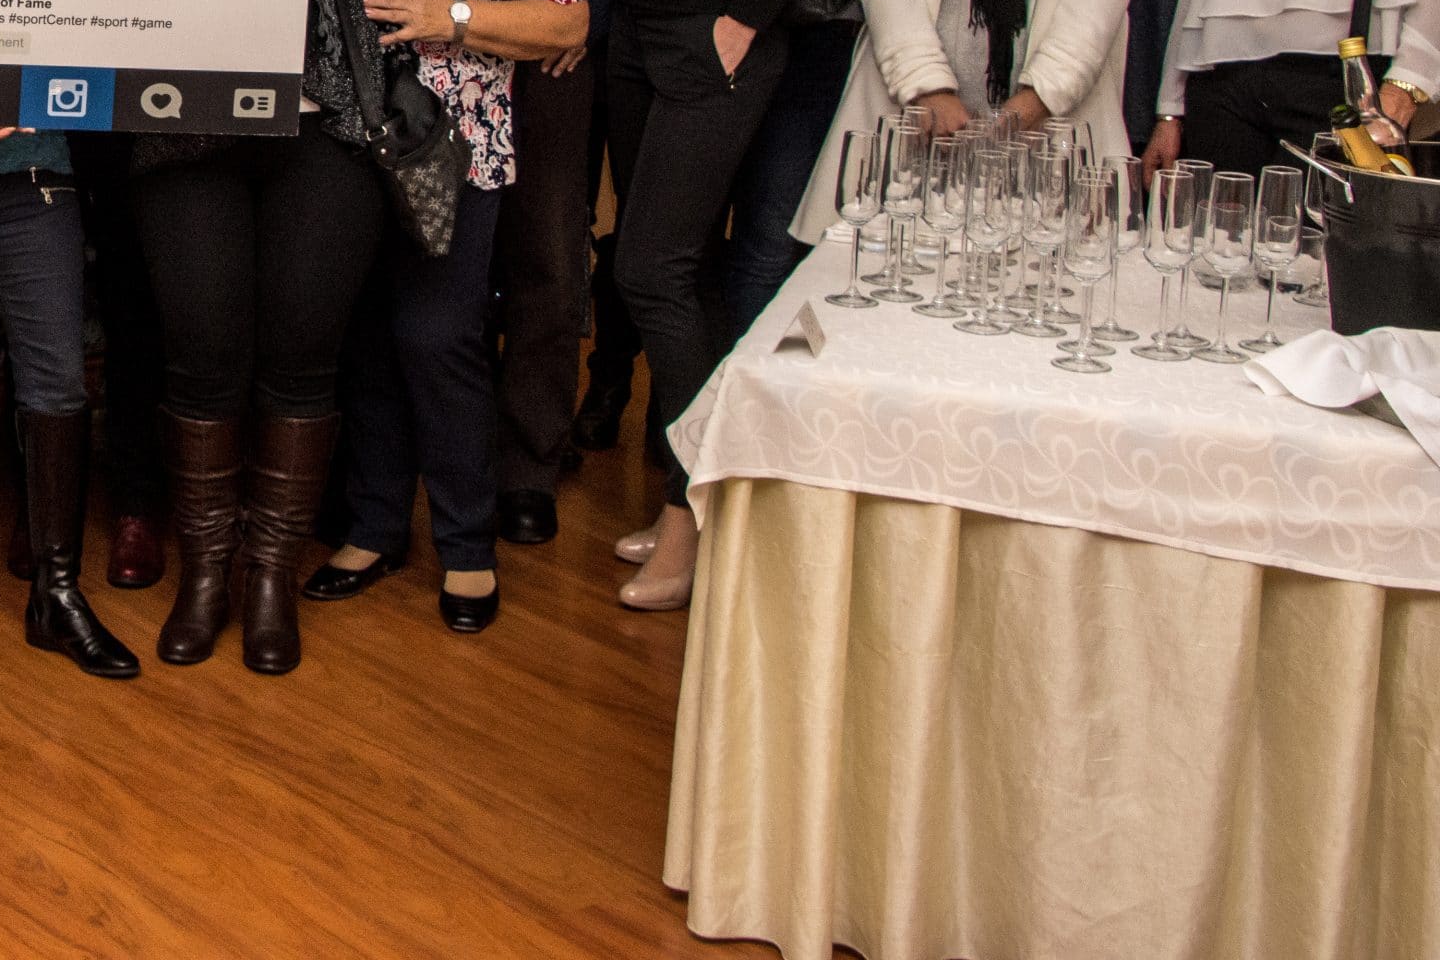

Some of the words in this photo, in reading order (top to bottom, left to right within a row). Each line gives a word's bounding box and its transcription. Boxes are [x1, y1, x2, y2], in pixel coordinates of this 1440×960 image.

[8, 13, 87, 26] #sportCenter
[90, 16, 128, 29] #sport
[131, 18, 173, 31] #game
